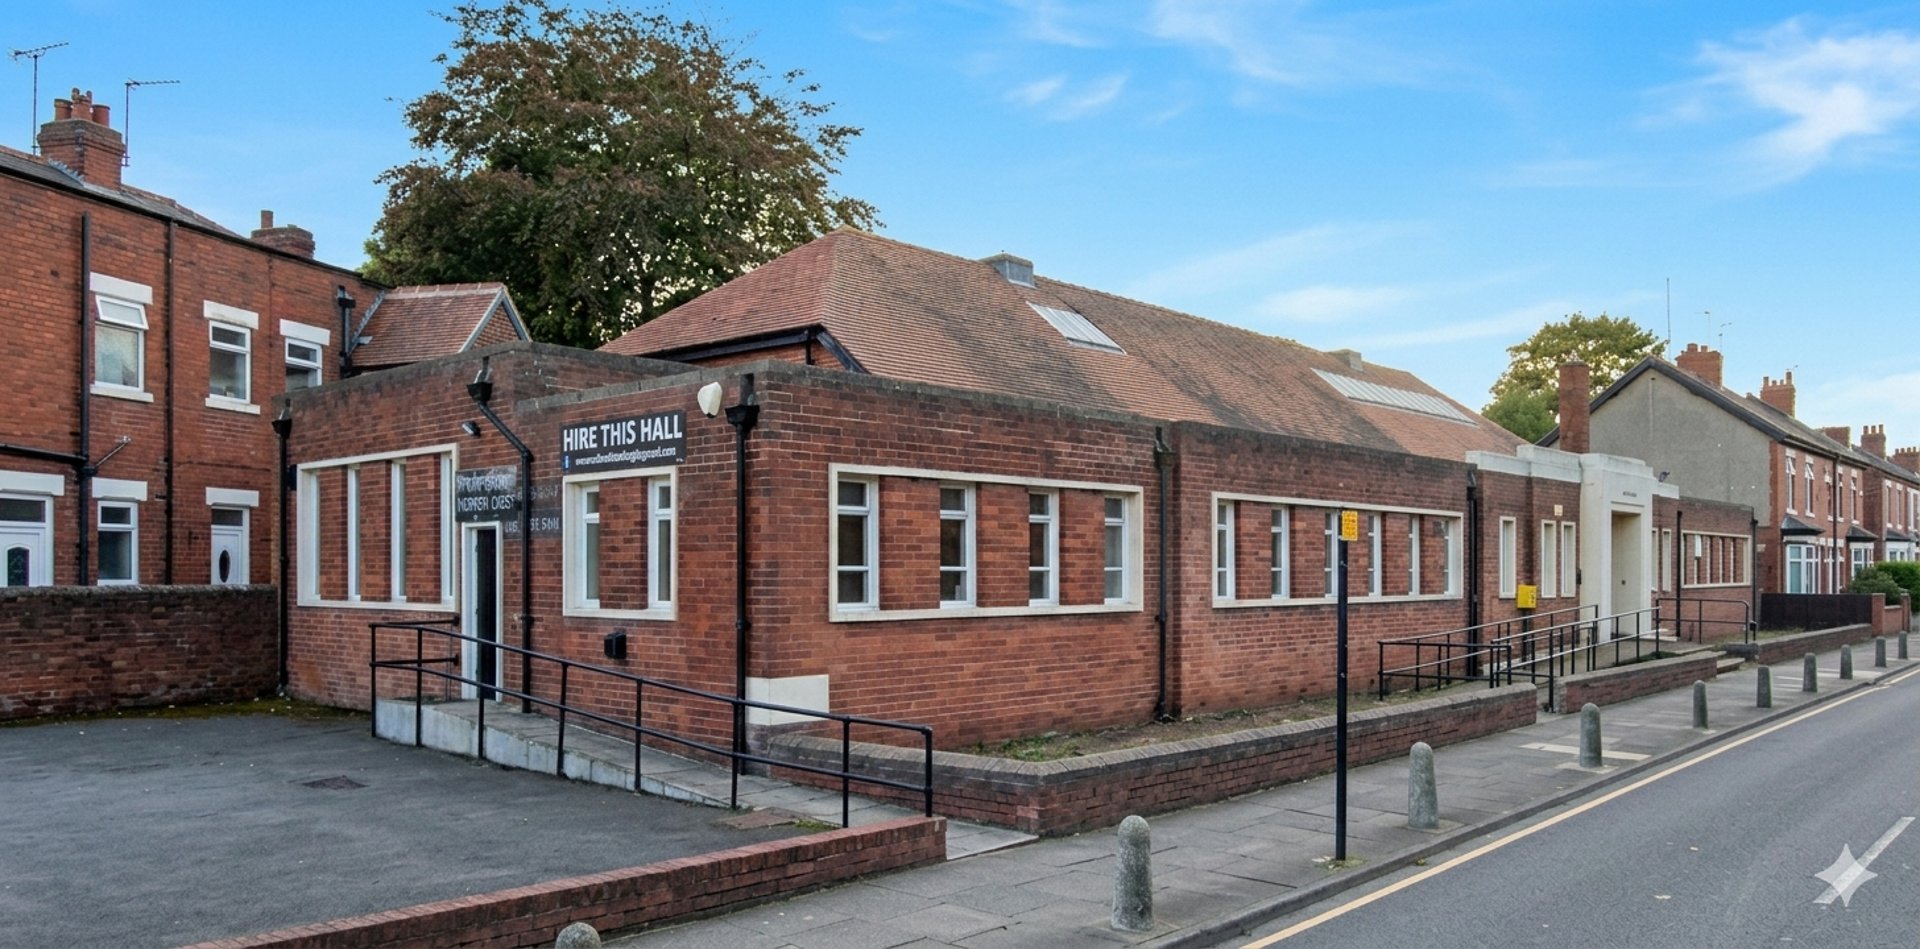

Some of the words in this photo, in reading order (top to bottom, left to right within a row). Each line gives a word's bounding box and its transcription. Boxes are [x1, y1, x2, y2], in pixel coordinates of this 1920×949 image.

[563, 425, 598, 452] HIRE
[600, 420, 636, 447] THIS
[640, 414, 683, 442] HALL
